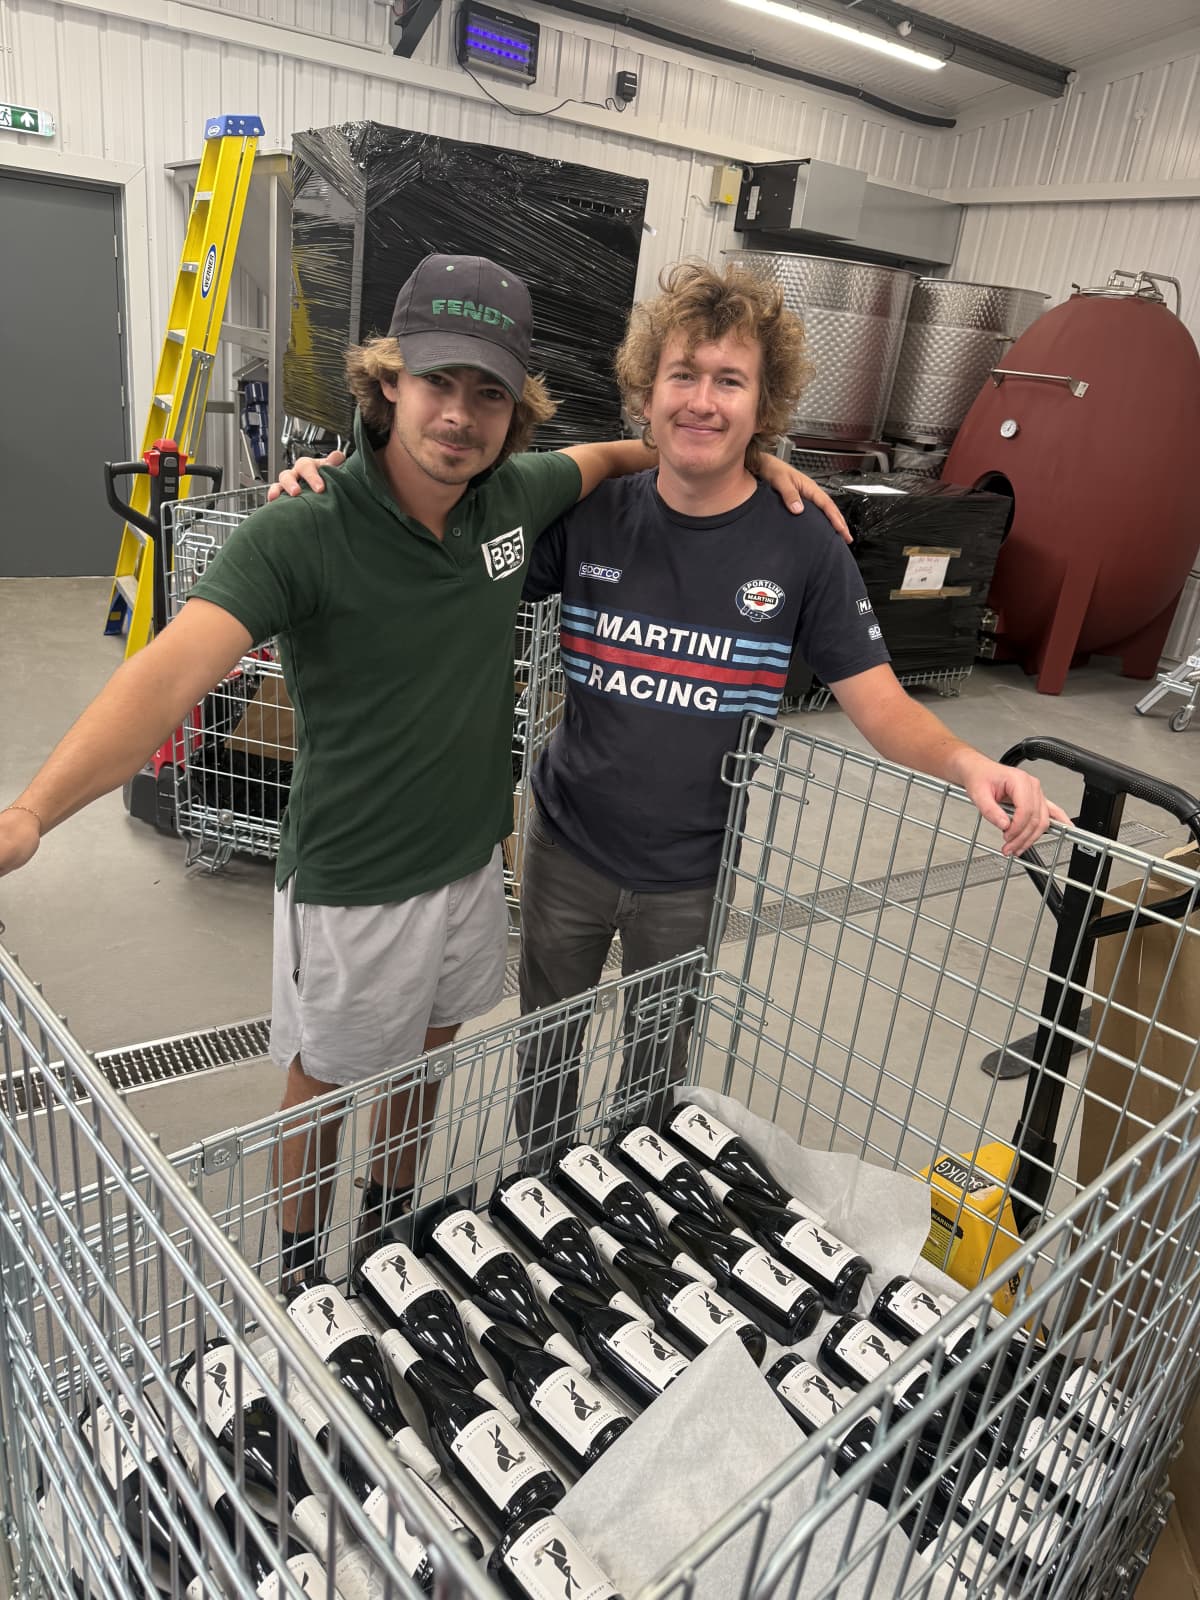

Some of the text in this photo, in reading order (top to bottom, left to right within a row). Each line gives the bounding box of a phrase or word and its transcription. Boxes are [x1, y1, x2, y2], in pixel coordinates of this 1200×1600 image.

[204, 254, 214, 288] WERNER
[432, 300, 515, 331] FENDT
[580, 564, 620, 580] sparco
[742, 580, 784, 599] SPORTLINE
[595, 612, 732, 661] MARTINI
[588, 664, 718, 712] RACING
